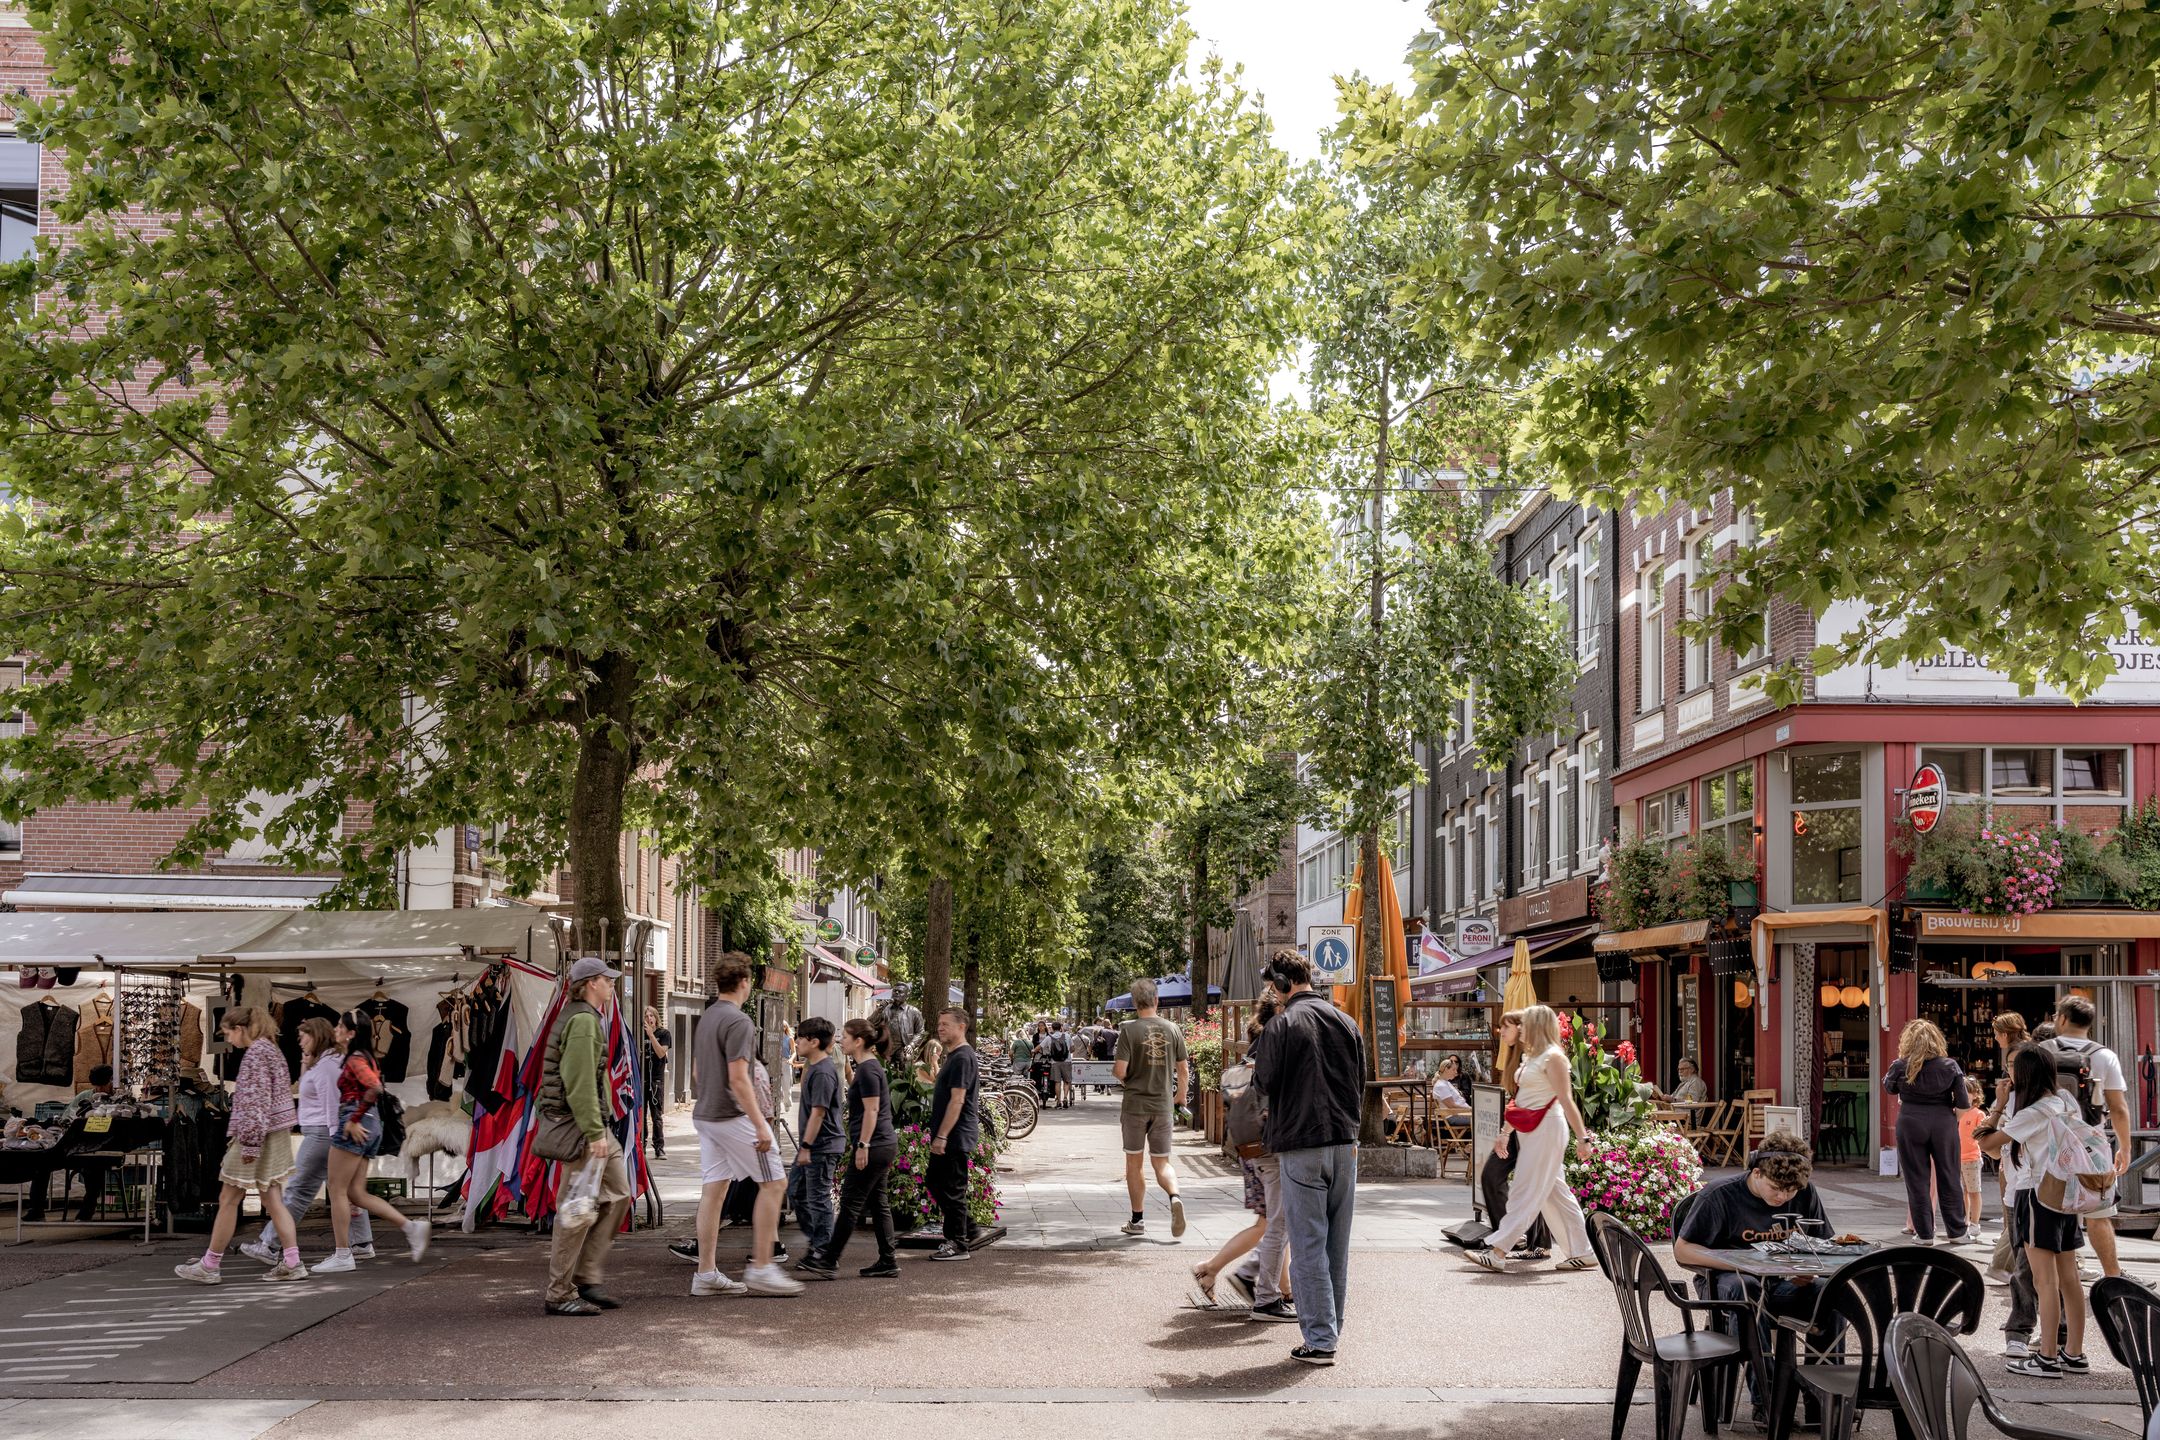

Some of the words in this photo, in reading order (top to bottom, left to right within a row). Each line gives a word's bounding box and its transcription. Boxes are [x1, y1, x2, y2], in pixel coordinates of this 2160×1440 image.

[1528, 899, 1551, 917] WALDO
[1928, 916, 1999, 930] BROUWERIJ
[1462, 934, 1491, 942] PERONI
